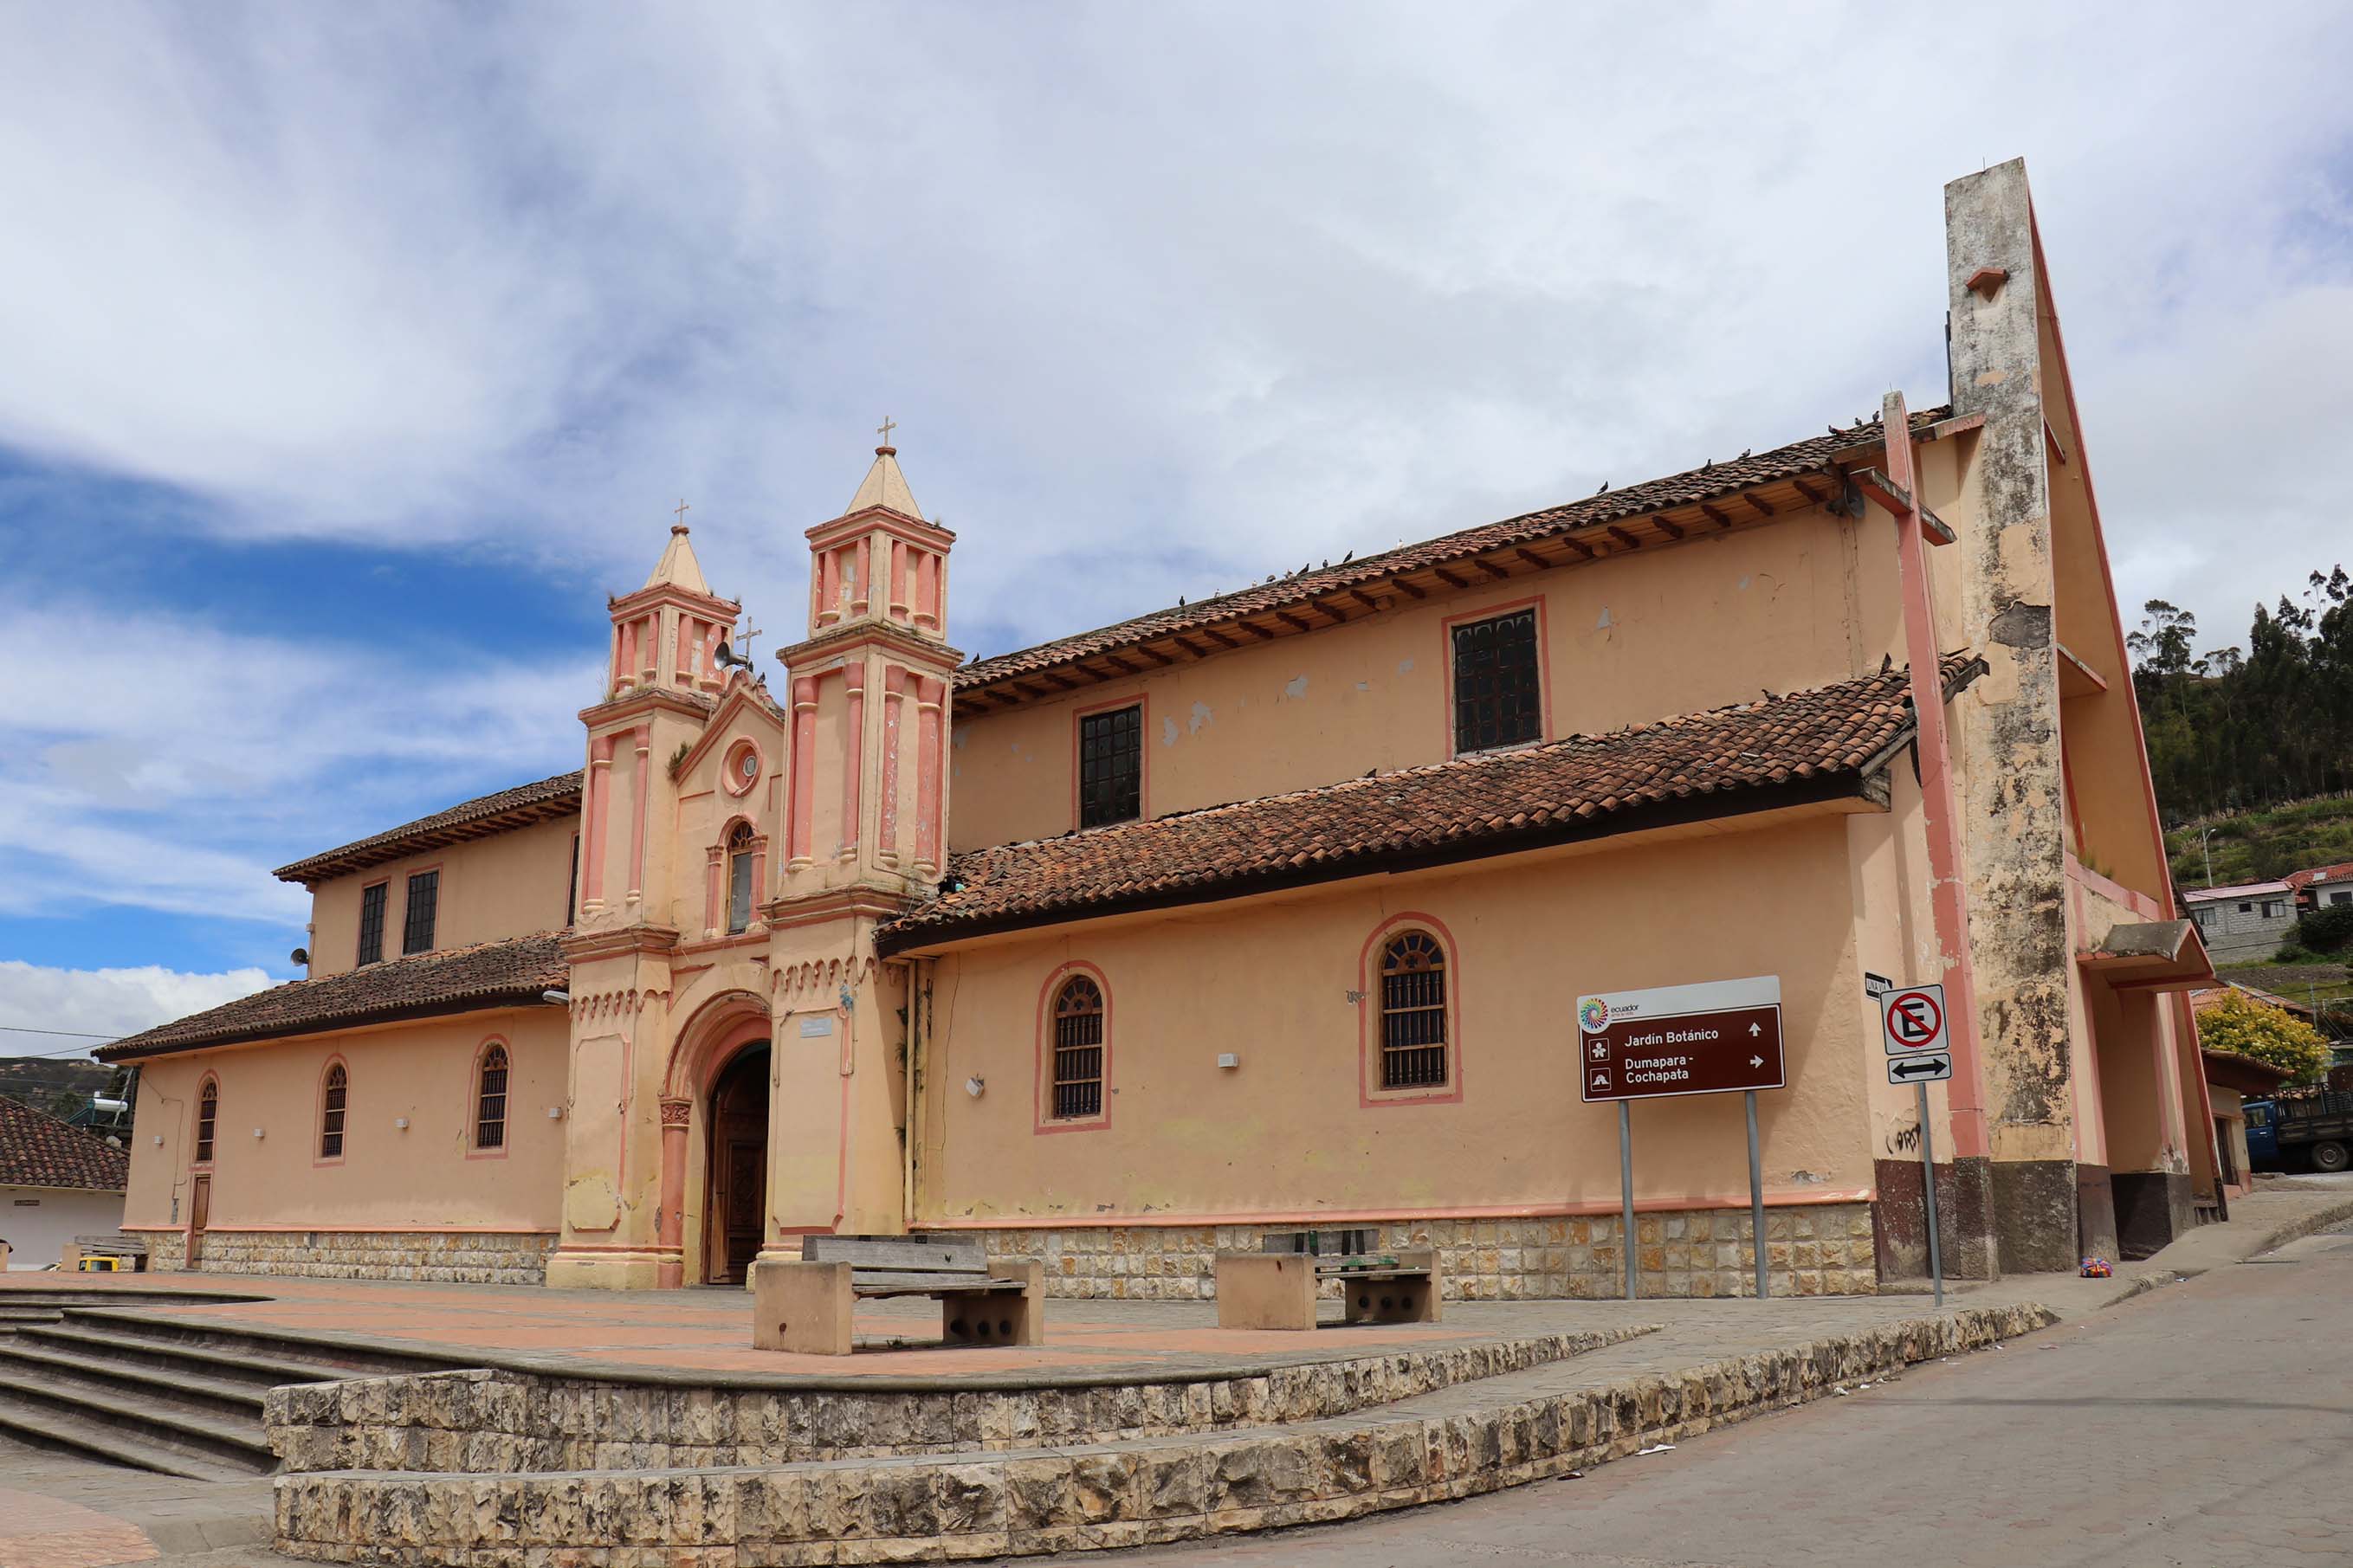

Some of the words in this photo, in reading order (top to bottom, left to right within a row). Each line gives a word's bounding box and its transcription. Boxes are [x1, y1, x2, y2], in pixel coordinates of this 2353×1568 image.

[1867, 979, 1879, 992] UNA
[1611, 1003, 1639, 1013] ecuador
[1900, 1002, 1929, 1037] E
[1666, 1028, 1719, 1043] Botánico
[1625, 1055, 1686, 1069] Dumapara
[1626, 1068, 1689, 1083] Cochapata
